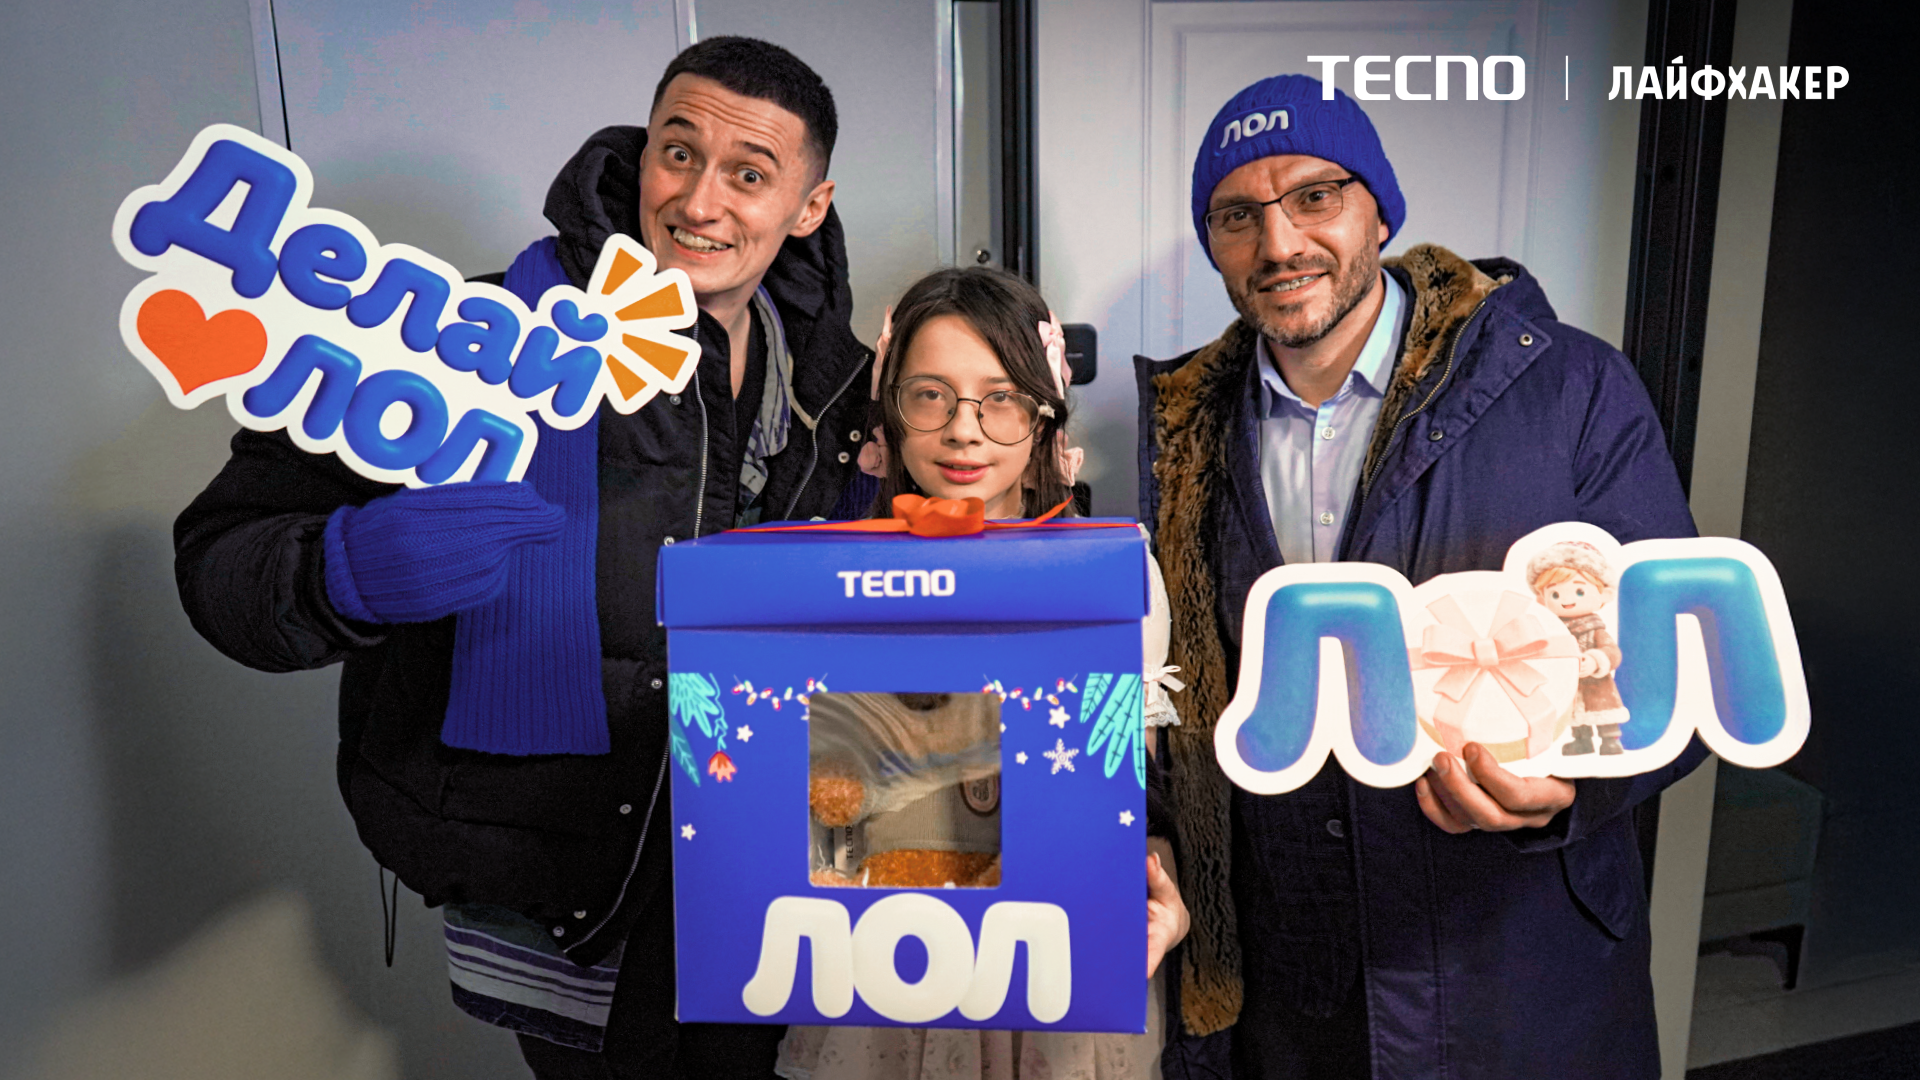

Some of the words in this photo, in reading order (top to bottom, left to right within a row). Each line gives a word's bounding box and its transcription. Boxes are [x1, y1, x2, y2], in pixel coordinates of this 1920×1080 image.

[129, 138, 609, 418] Делай
[836, 569, 956, 598] TECNO
[742, 892, 1072, 1024] ЛОЛ
